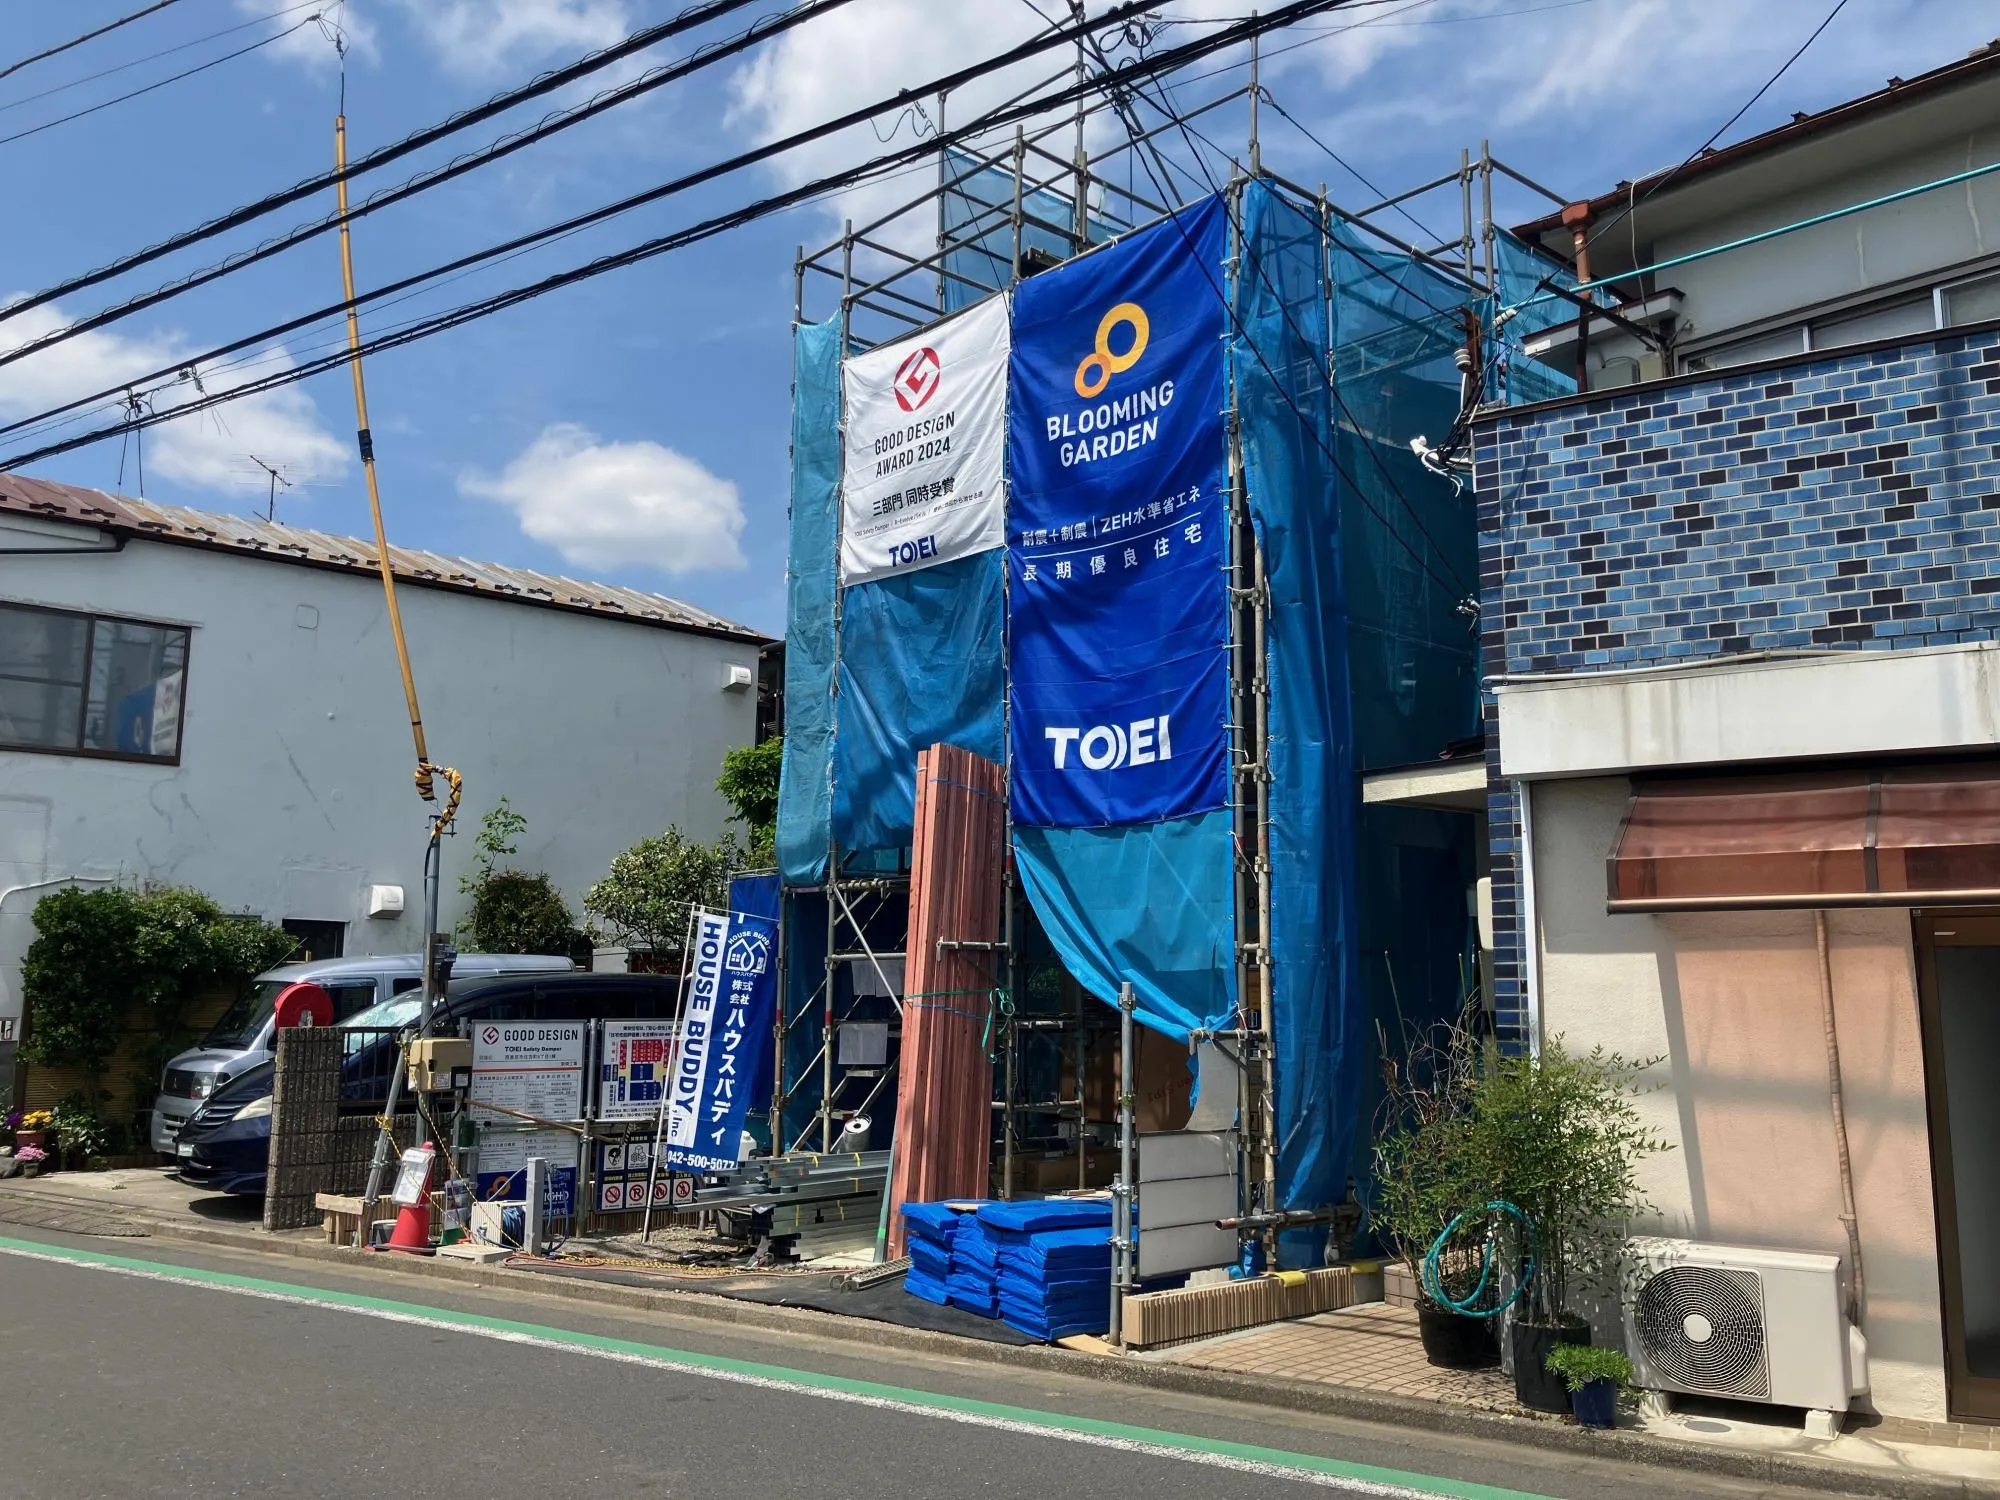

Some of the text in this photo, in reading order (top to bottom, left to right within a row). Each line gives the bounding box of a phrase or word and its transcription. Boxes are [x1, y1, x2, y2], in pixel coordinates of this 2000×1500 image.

[874, 411, 955, 455] GOOD DESIGN
[1047, 380, 1174, 441] BLOOMING
[875, 436, 951, 478] AWARD 2024
[1060, 416, 1158, 467] GARDEN
[872, 492, 903, 517] 三部門
[905, 476, 955, 507] 同時受賞
[1101, 485, 1201, 533] ZEH水準省エネ
[888, 535, 938, 567] TOEI
[1023, 523, 1202, 581] 長期優良住宅
[1045, 714, 1172, 770] TOEI
[727, 930, 772, 950] HOUSE BUDDY
[692, 922, 722, 1012] HOUSE
[731, 970, 758, 979] ハウスバディ
[504, 1029, 578, 1041] GOOD DESIGN
[710, 1008, 745, 1146] ハウスバディ
